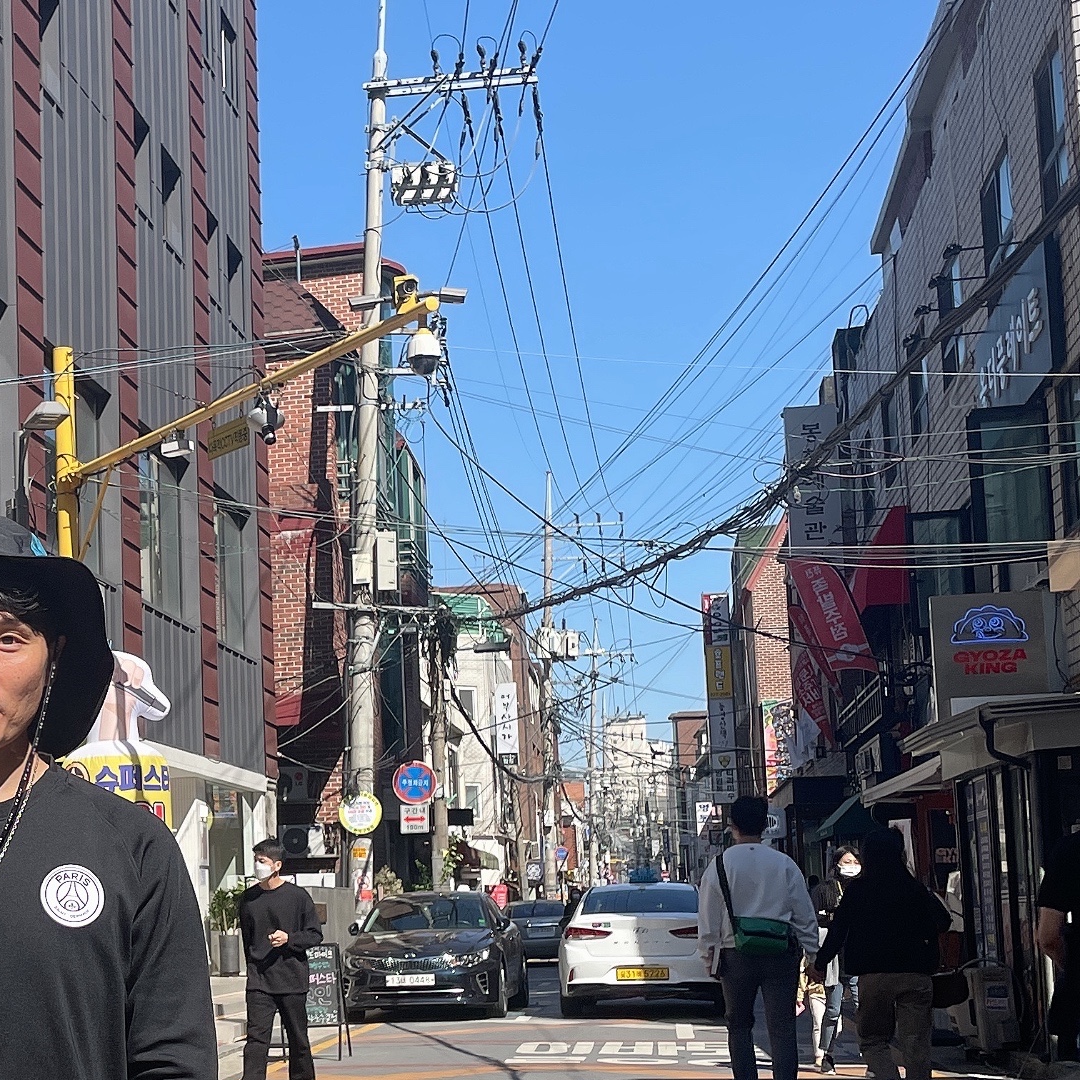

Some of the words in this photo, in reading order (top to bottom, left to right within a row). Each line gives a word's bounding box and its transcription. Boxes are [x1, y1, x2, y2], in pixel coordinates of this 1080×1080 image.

[953, 648, 1028, 664] GYOZA
[963, 661, 1018, 675] KING
[55, 872, 91, 887] PARIS
